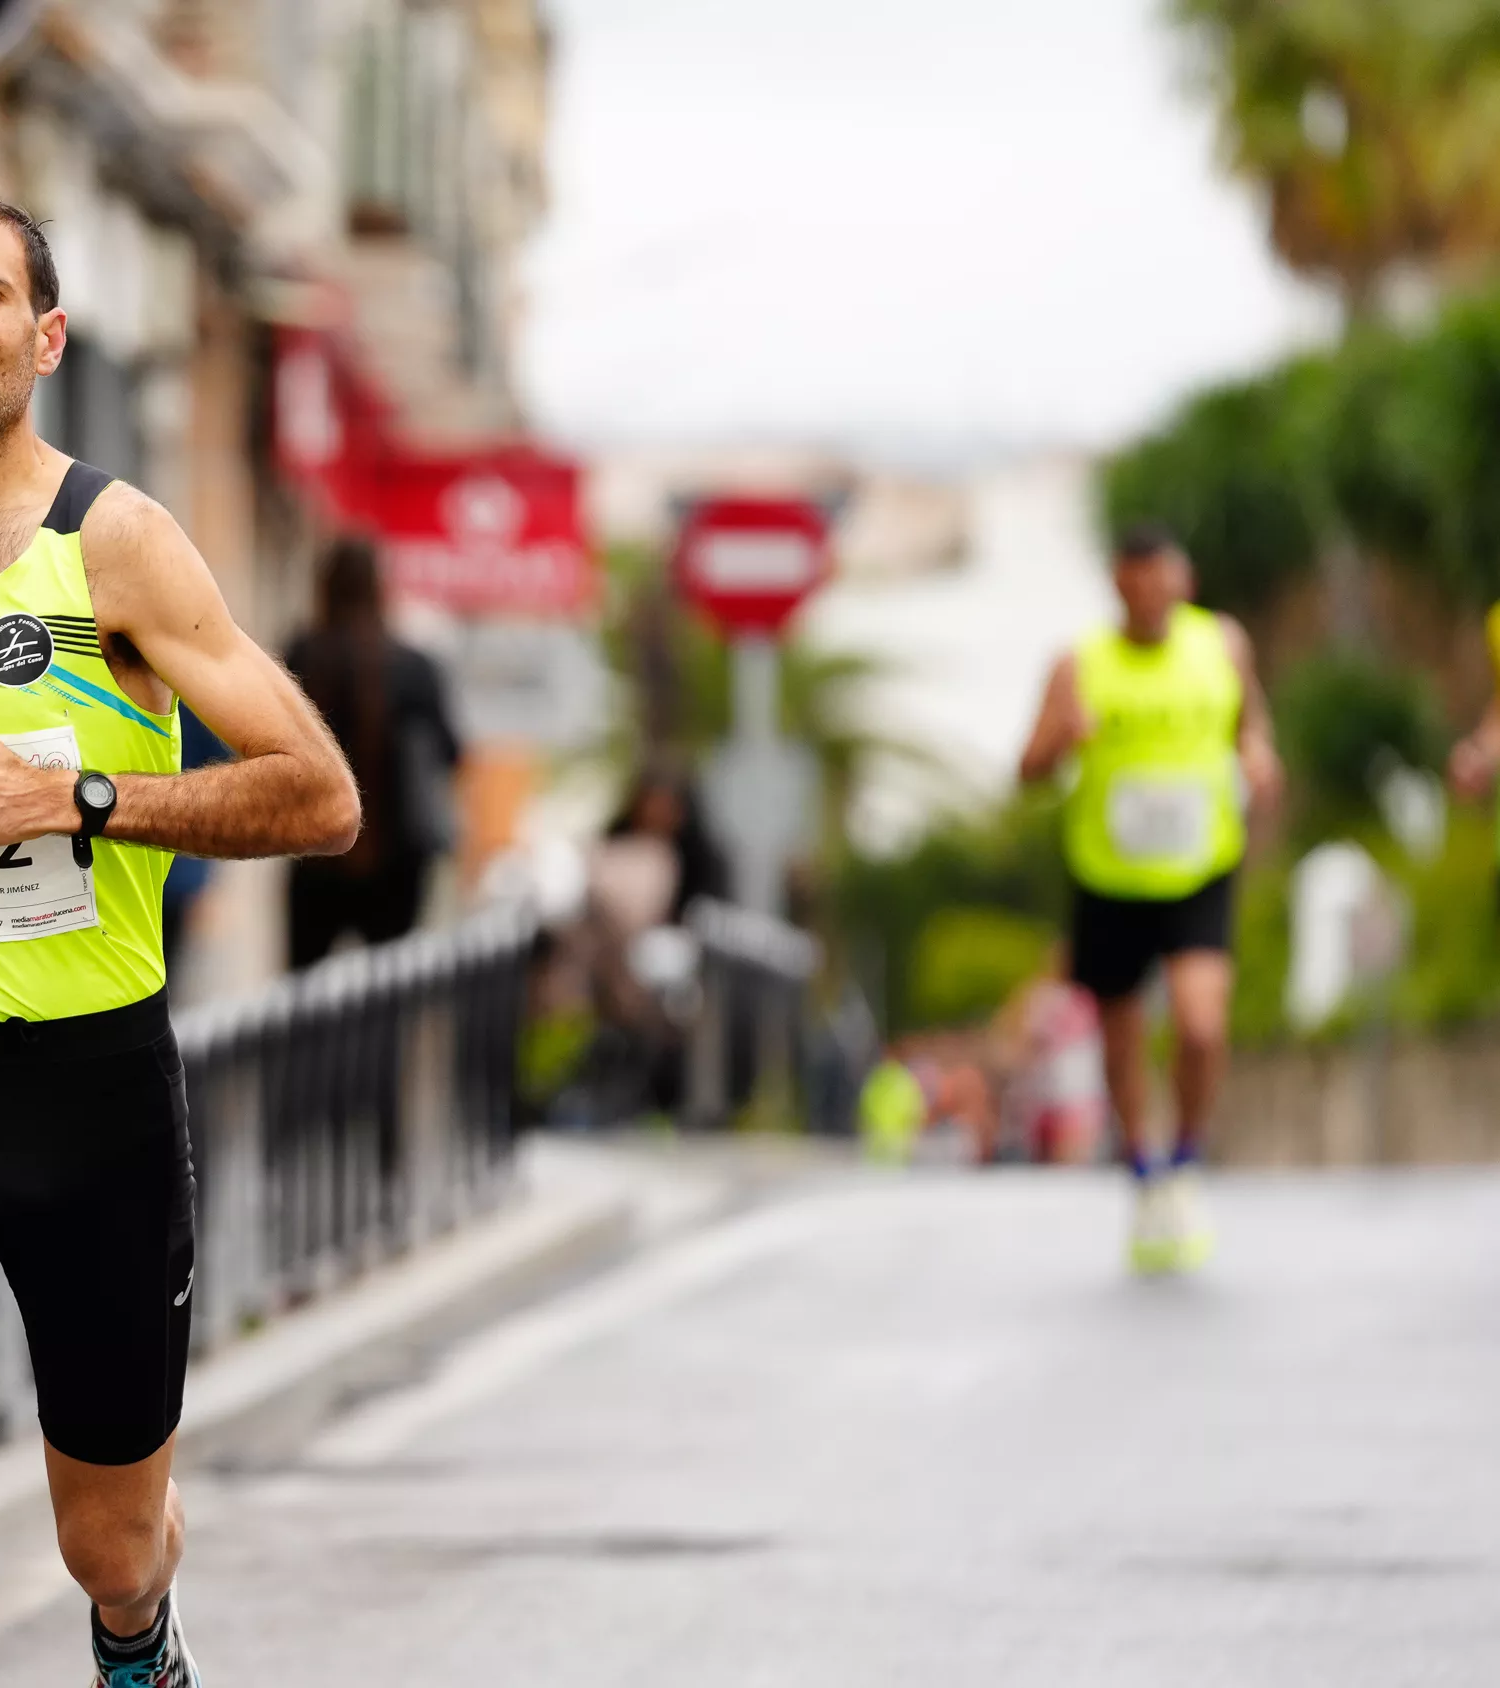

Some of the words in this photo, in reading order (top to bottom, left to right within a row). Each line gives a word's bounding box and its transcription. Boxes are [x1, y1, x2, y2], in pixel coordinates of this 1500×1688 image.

[16, 659, 26, 667] del
[27, 654, 44, 664] Canal
[6, 883, 40, 894] JIMÉNEZ
[11, 904, 87, 924] mediamaratonlucena.com
